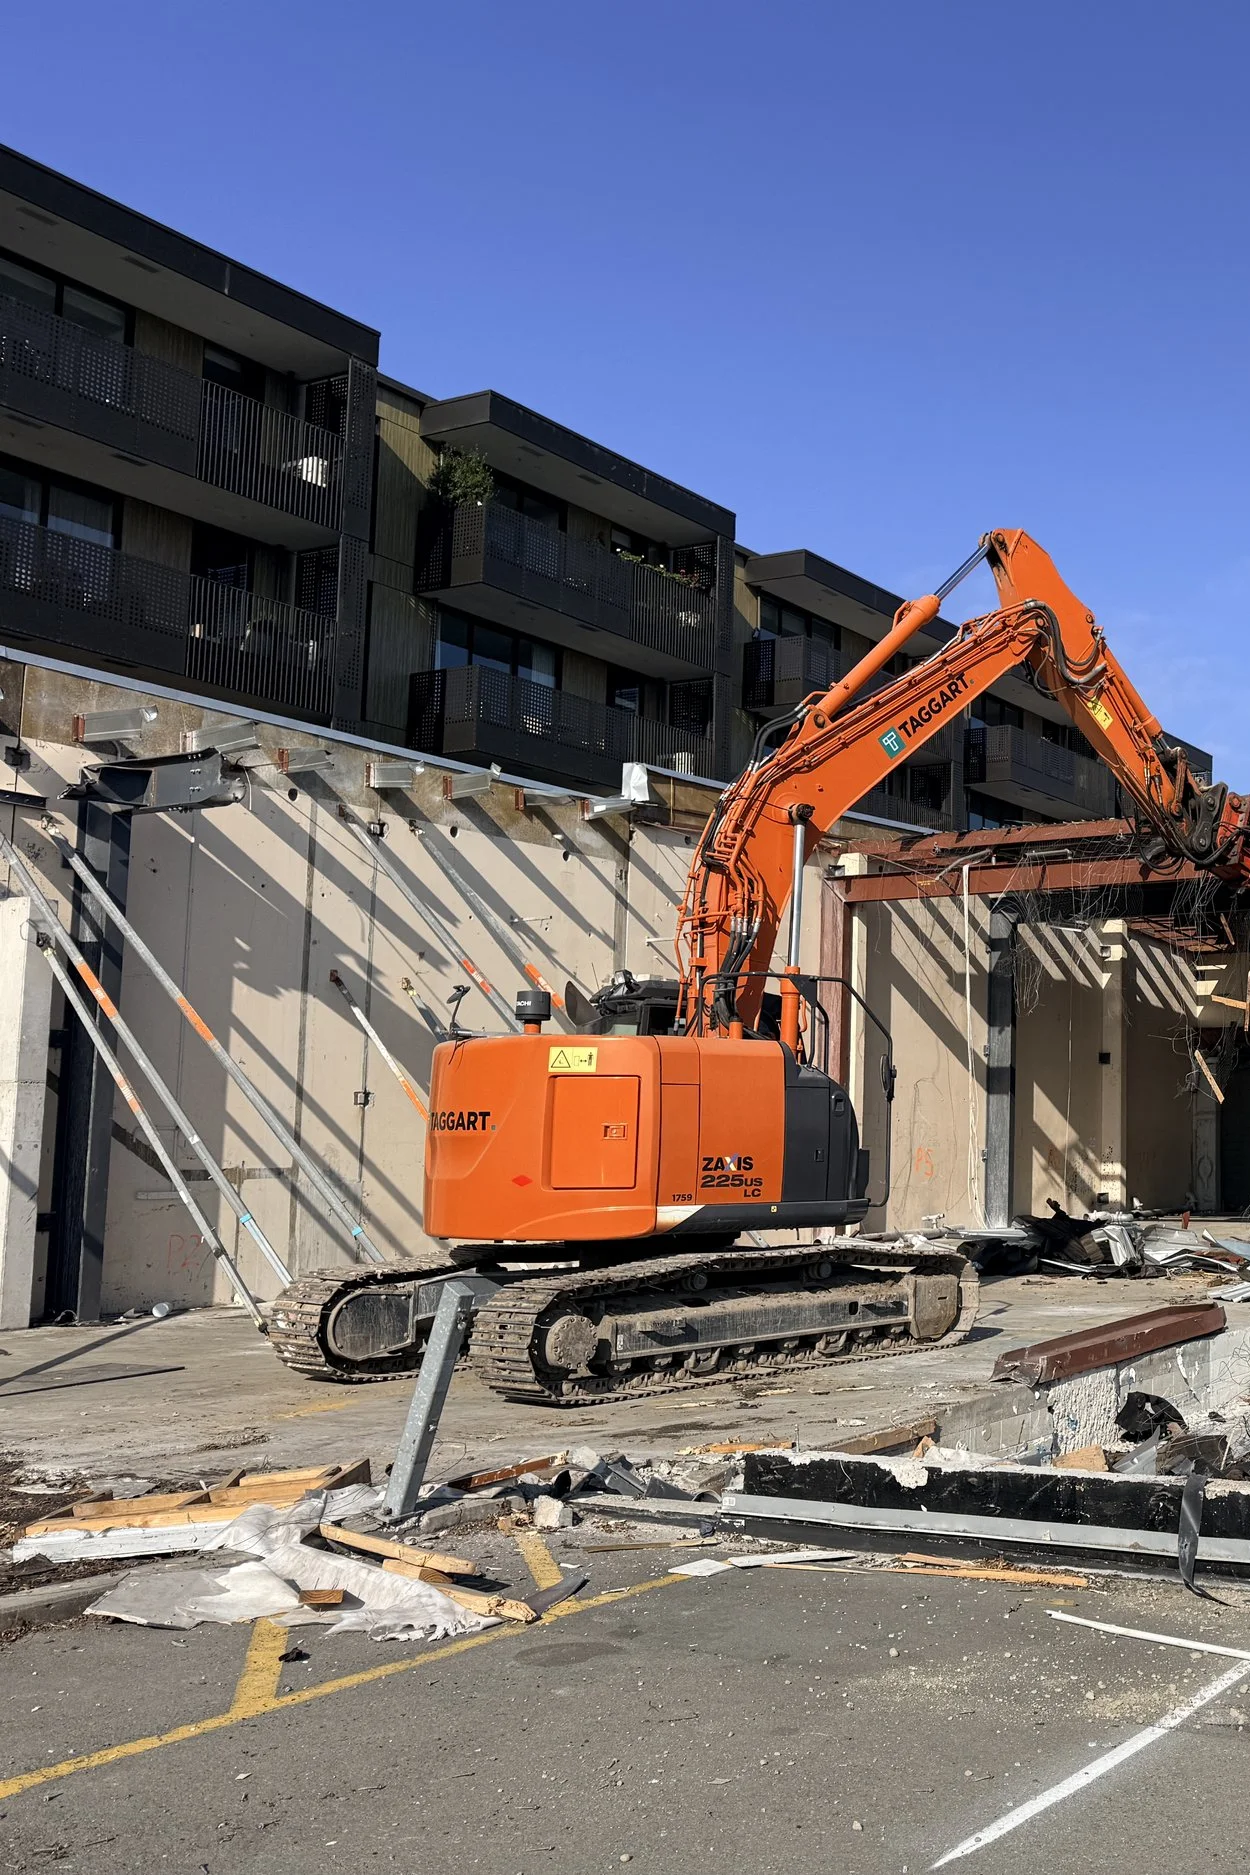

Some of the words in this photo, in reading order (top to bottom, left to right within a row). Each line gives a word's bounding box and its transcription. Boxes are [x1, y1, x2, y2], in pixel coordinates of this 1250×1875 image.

[702, 1153, 754, 1172] ZAXIS
[744, 1188, 761, 1197] LC
[672, 1194, 693, 1202] 1759
